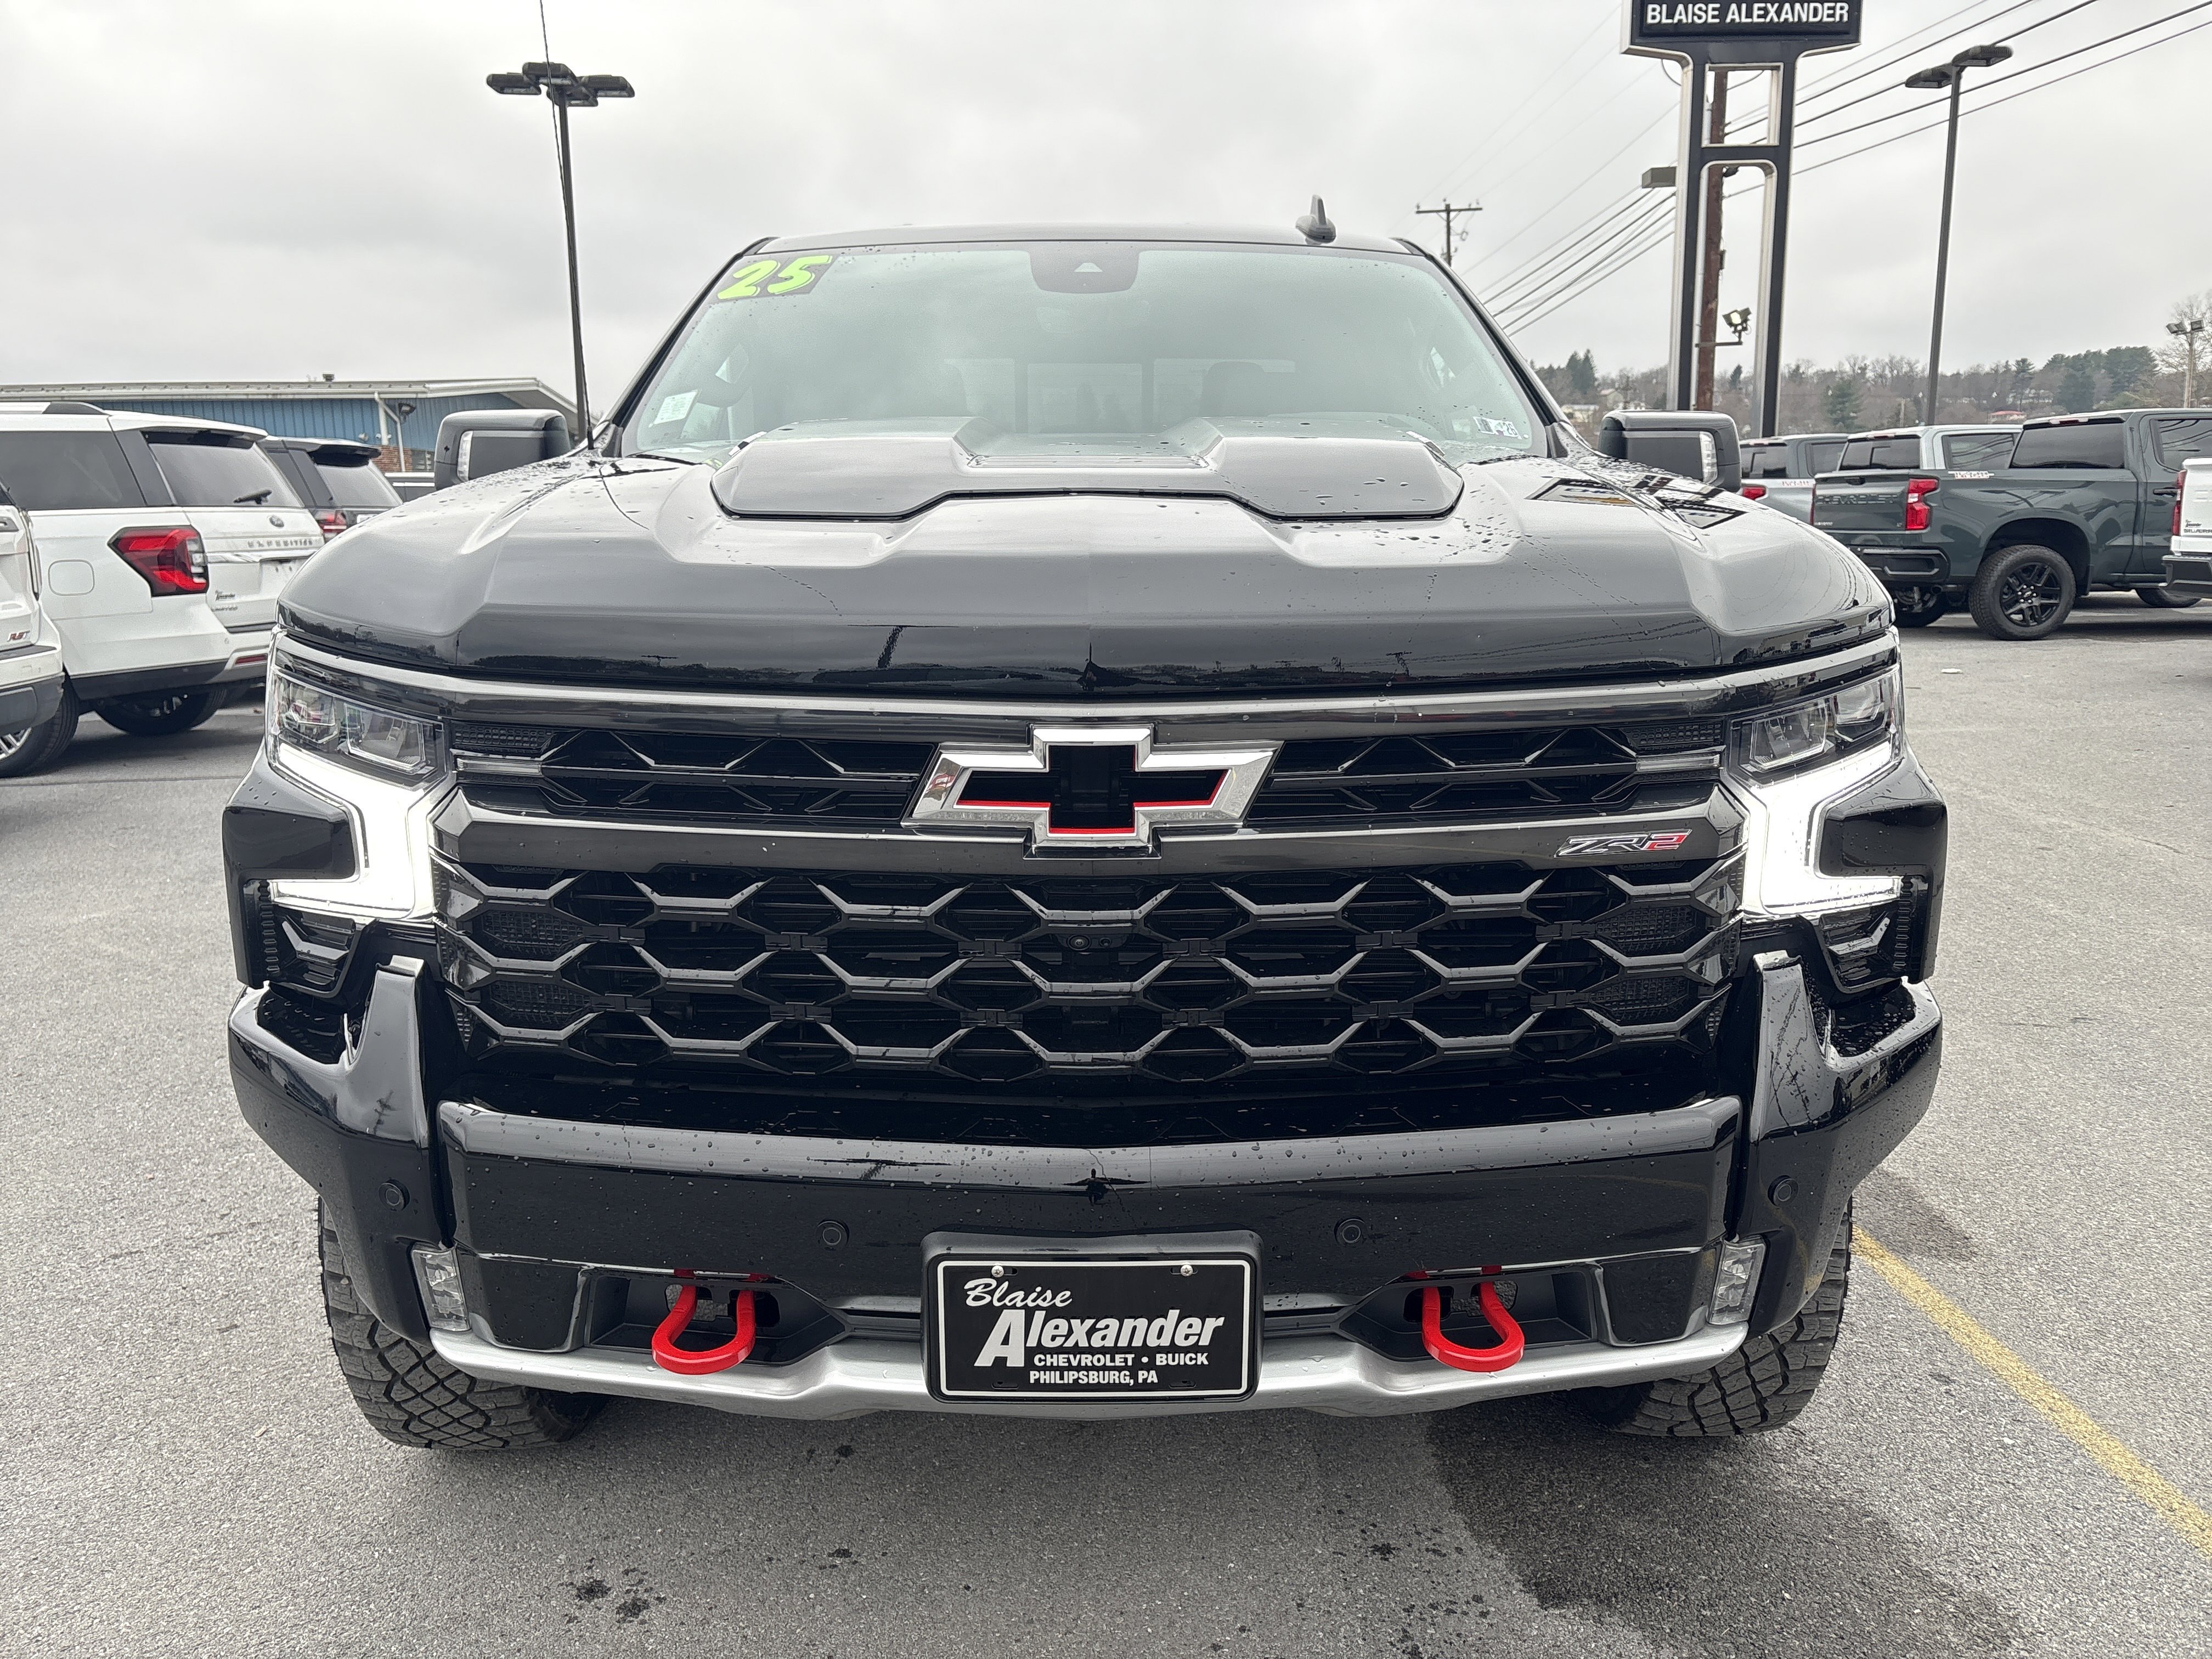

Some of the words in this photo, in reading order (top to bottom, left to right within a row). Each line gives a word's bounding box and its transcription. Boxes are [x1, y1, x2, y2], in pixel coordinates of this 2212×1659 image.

[1646, 3, 1721, 24] BLAISE
[1725, 2, 1849, 23] ALEXANDER
[718, 255, 833, 300] 25
[1554, 828, 1692, 858] ZR2
[963, 1277, 1073, 1307] Blaise
[973, 1308, 1225, 1367] Alexander
[1033, 1353, 1135, 1367] CHEVROLET
[1155, 1352, 1209, 1366] BUICK
[1029, 1370, 1135, 1386] PHILIPSBURG,
[1137, 1370, 1159, 1384] PA
